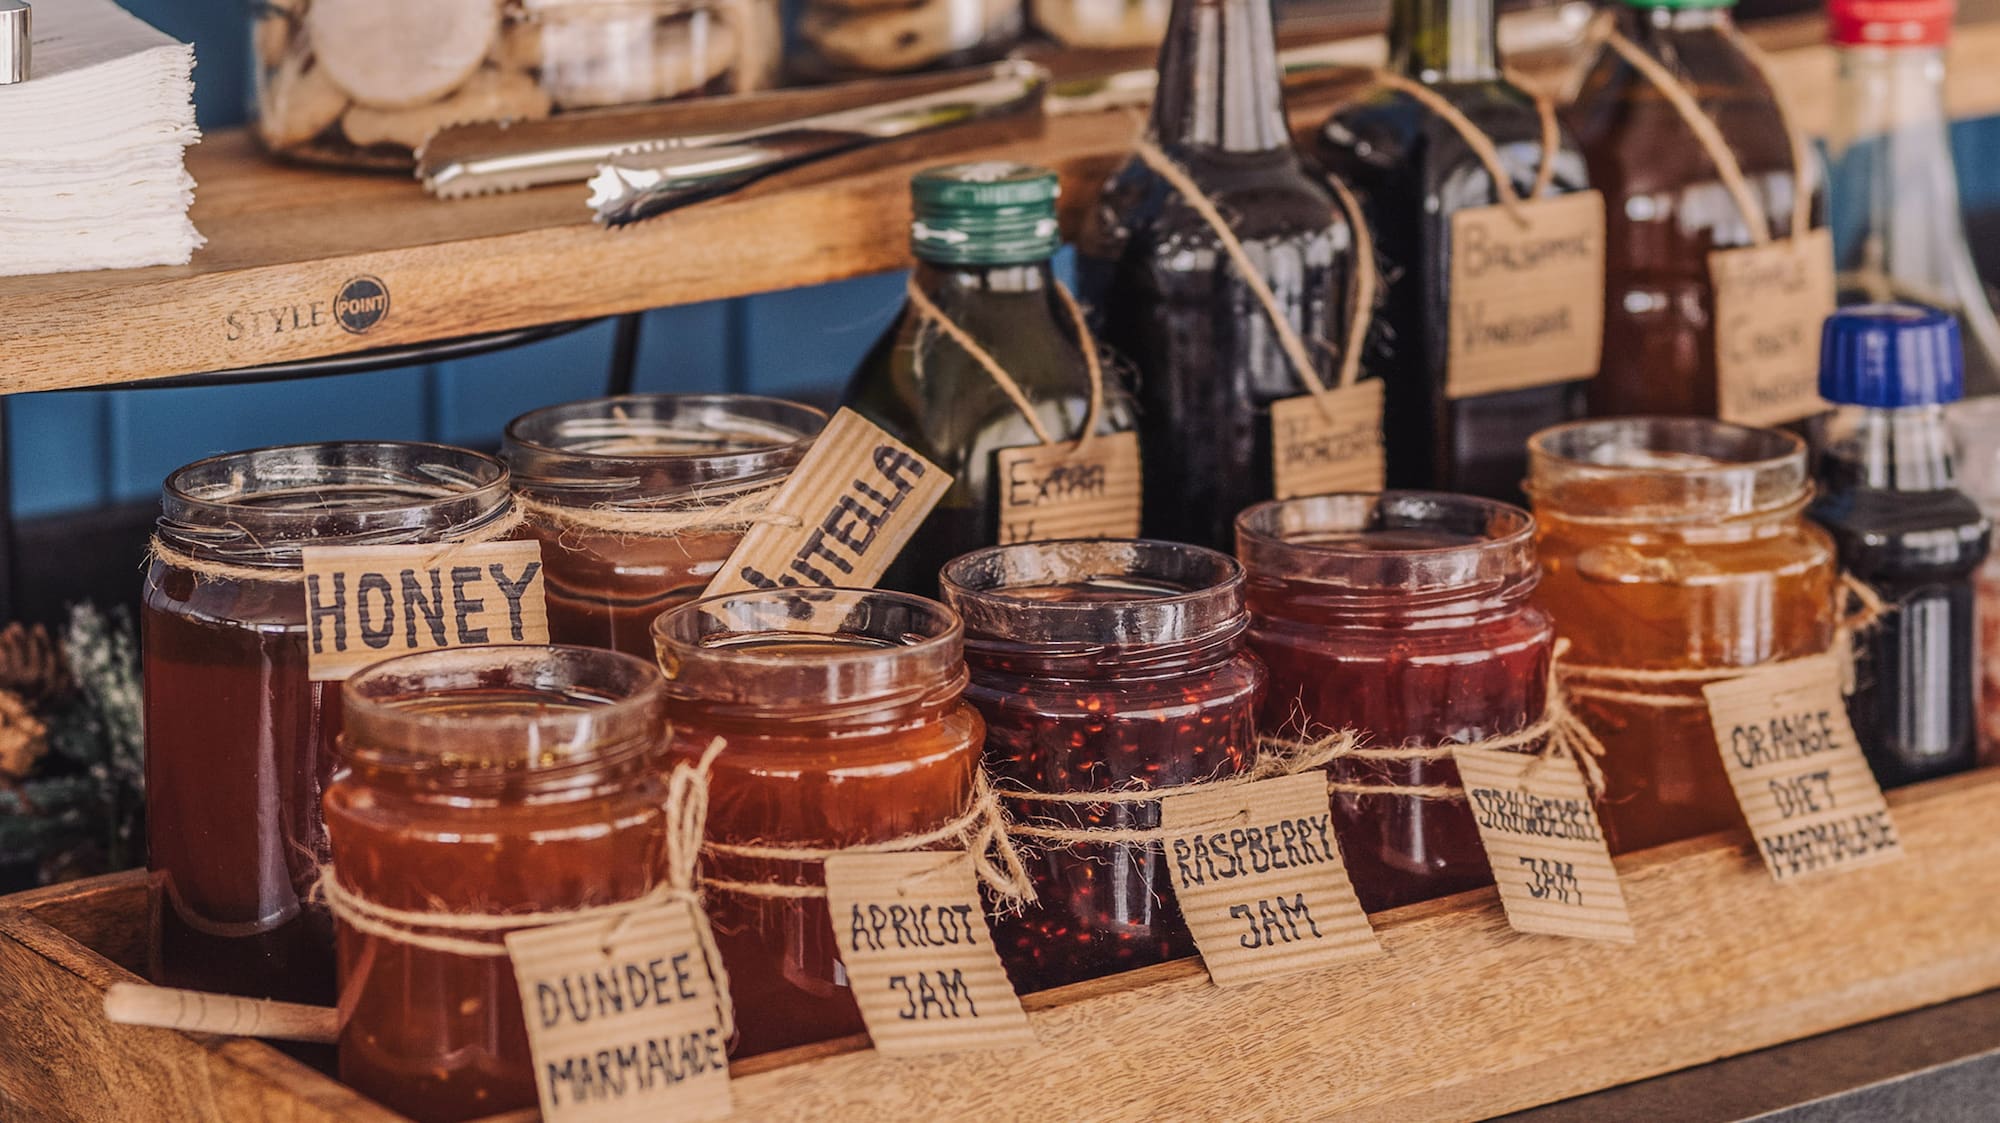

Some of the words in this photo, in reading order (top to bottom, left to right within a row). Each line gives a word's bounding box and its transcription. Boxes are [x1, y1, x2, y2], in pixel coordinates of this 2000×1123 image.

[226, 300, 325, 341] STYLE
[339, 295, 385, 315] POINT
[307, 562, 542, 654] HONEY
[1731, 711, 1841, 769] ORANGE
[1768, 770, 1836, 819] DIET
[1173, 814, 1335, 889] RASPBERRY
[1519, 856, 1583, 906] JAM
[851, 903, 977, 952] APRICOT
[1229, 893, 1323, 949] JAM
[537, 953, 697, 1028] DUNDEE
[889, 969, 979, 1020] JAM
[548, 1028, 723, 1106] MARMALADE
